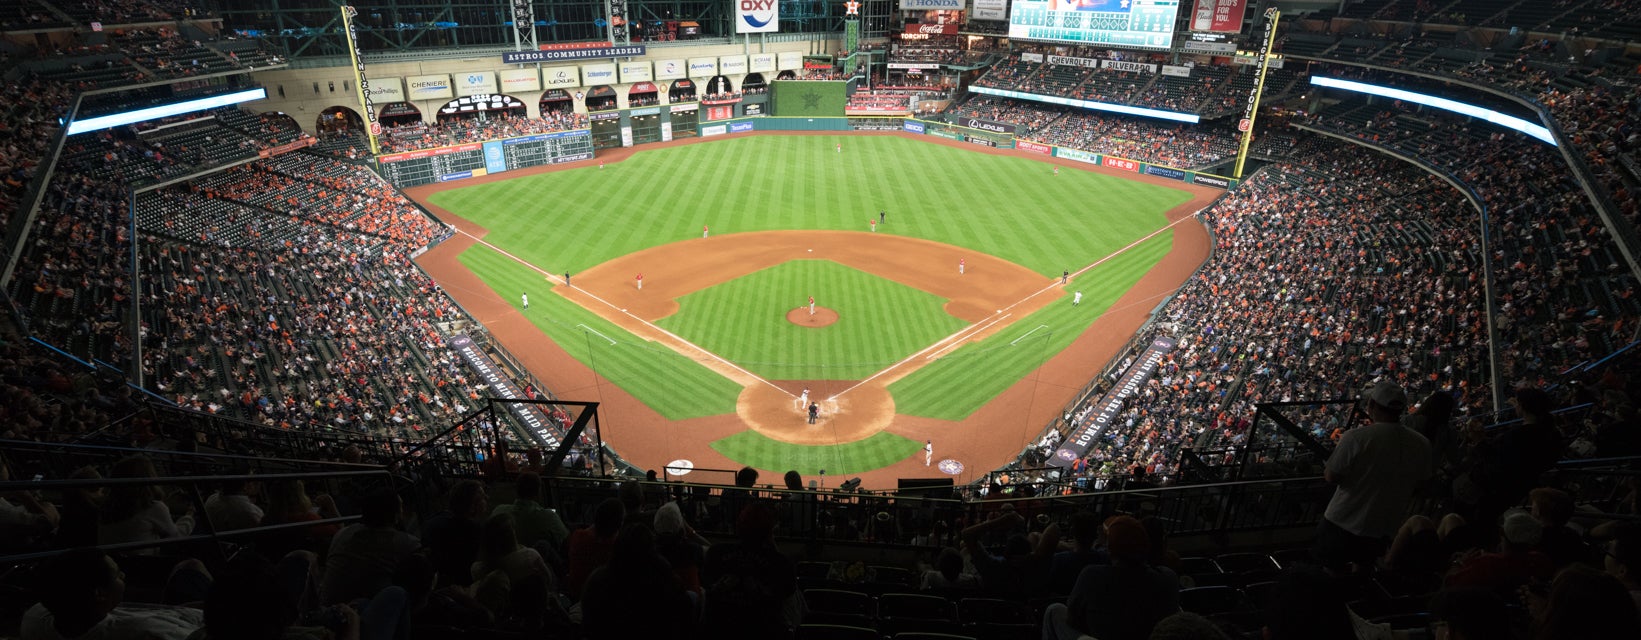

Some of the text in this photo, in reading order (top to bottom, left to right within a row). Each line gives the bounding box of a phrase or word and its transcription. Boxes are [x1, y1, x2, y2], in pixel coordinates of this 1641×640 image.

[741, 0, 775, 10] OXY
[547, 50, 602, 58] COMMUNITY
[606, 48, 642, 56] LEADERS
[1051, 56, 1092, 66] CHEVROLET
[1108, 62, 1150, 72] SILVERADO
[412, 80, 447, 88] CHENIERE
[364, 90, 376, 122] FARE
[906, 124, 922, 132] GEICO
[979, 124, 1004, 132] LEXUS
[462, 346, 492, 374] WELCOME
[486, 374, 498, 382] TO
[495, 383, 523, 408] MINUE
[518, 408, 542, 428] MAID
[1076, 424, 1100, 447] HOME
[1096, 412, 1110, 424] OF
[1106, 399, 1122, 412] THE
[1118, 371, 1146, 398] HOUSTON
